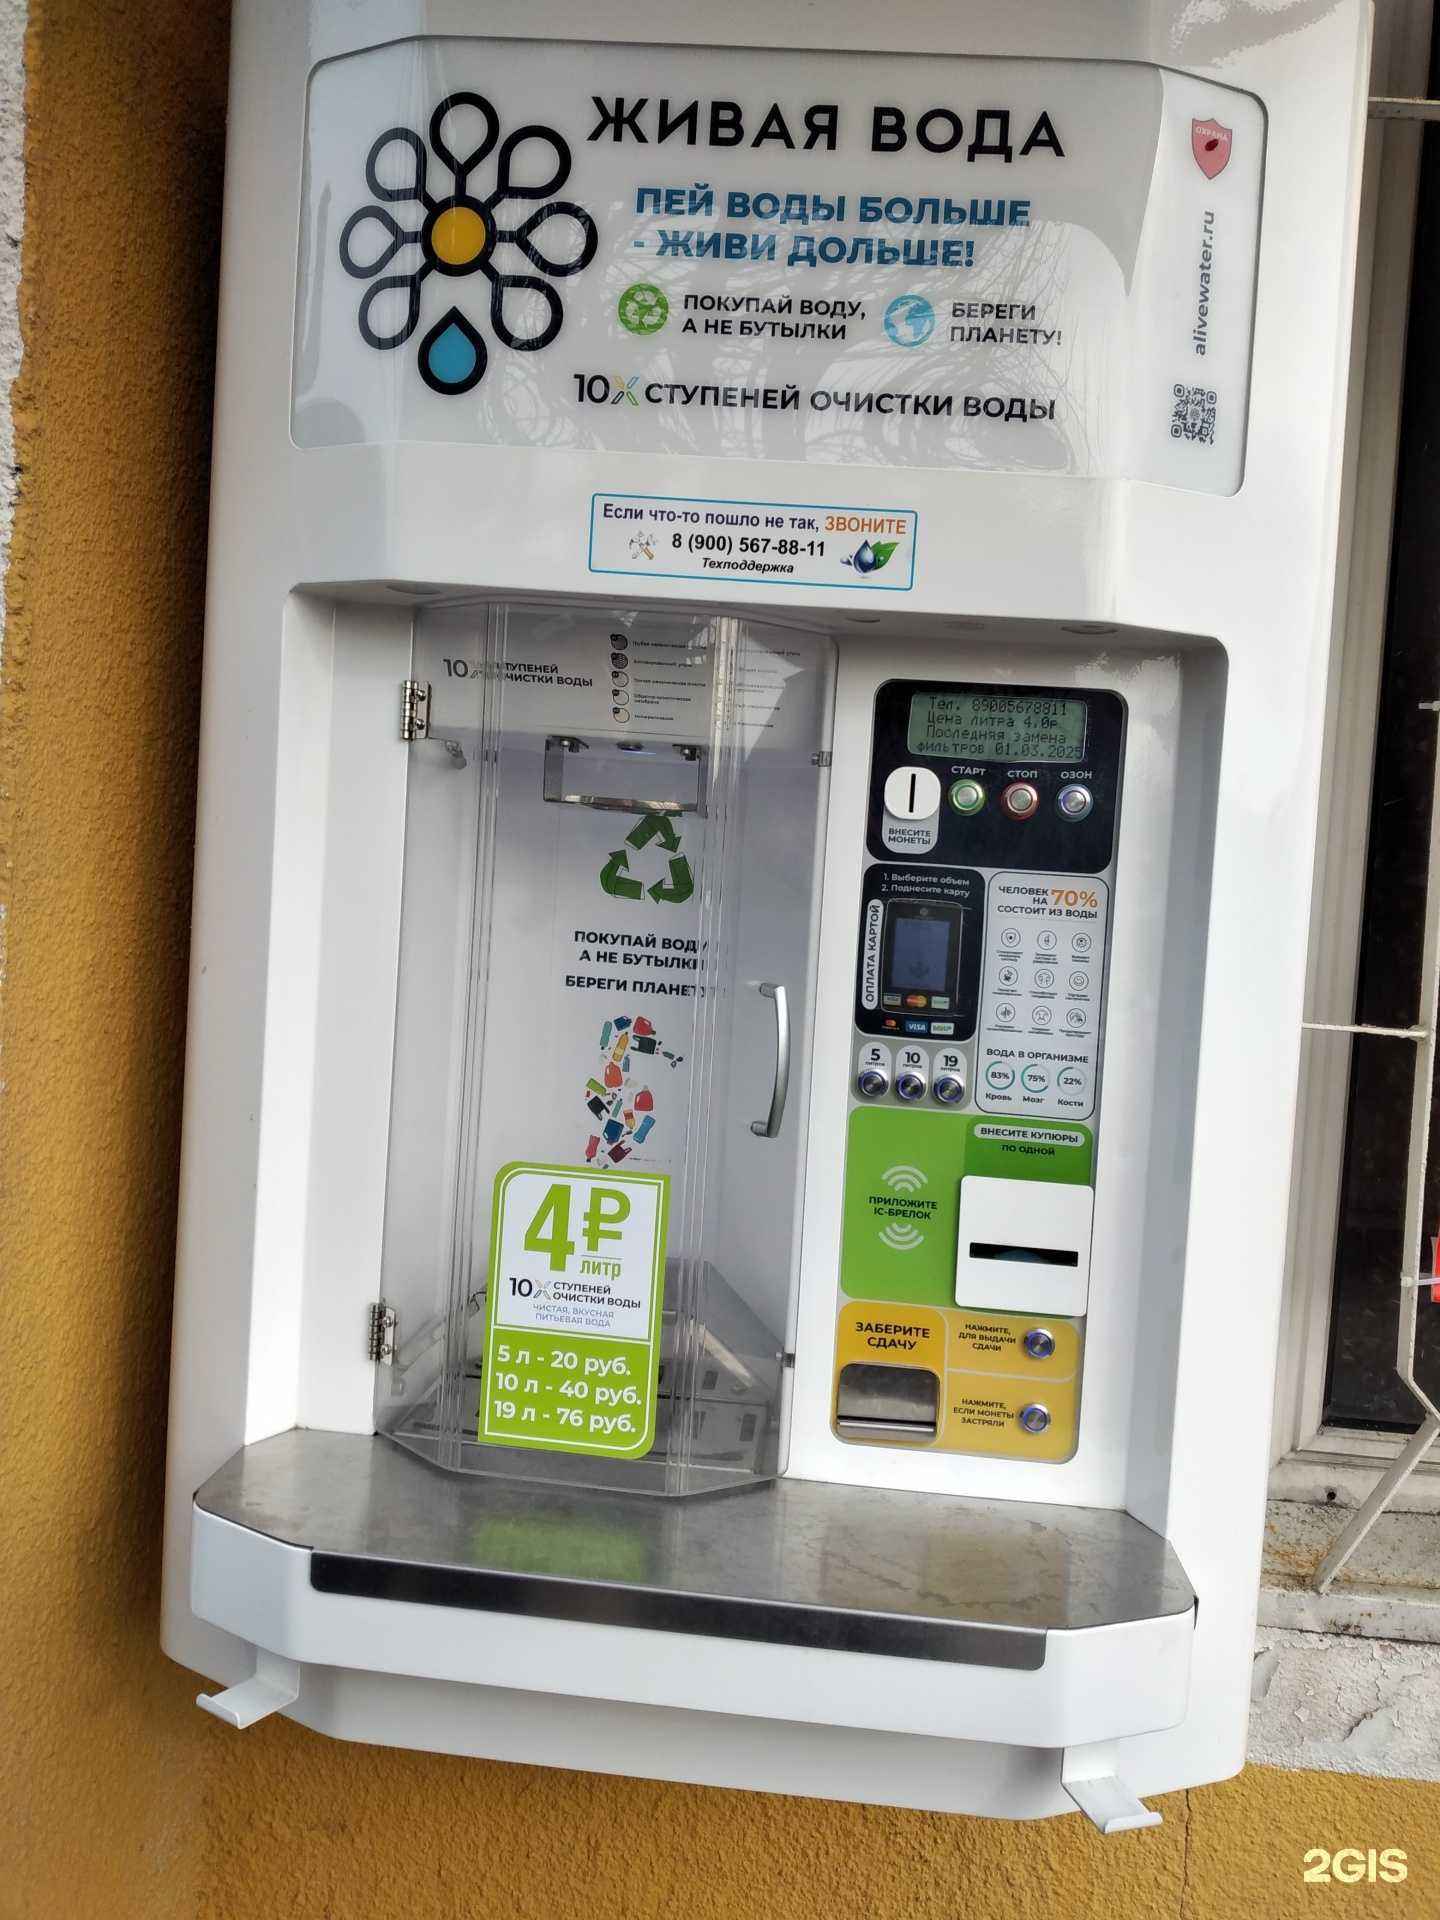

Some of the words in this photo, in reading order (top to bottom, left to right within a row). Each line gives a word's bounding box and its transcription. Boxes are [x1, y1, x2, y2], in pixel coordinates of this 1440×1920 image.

[586, 96, 838, 150] ЖИВАЯ
[871, 106, 1065, 163] ВОДА
[636, 182, 714, 217] ПЕЙ
[727, 191, 845, 225] ВОДЫ
[859, 196, 1031, 226] БОЛЬШЕ
[656, 230, 776, 261] ЖИВИ
[787, 235, 975, 268] ДОЛЬШЕ!
[1193, 210, 1215, 356] alivewater.ru
[683, 294, 792, 314] ПОКУПАЙ
[800, 300, 865, 320] ВОДУ,
[952, 302, 1035, 320] БЕРЕГИ
[682, 318, 697, 334] А
[704, 318, 732, 335] НЕ
[740, 320, 847, 340] БУТЫЛКИ
[950, 326, 1062, 346] ПЛАНЕТУ!
[645, 383, 800, 410] СТУПЕНЕЙ
[810, 390, 952, 416] ОЧИСТКИ
[963, 396, 1056, 422] ВОДЫ
[603, 503, 643, 520] Если
[649, 509, 700, 524] что-то
[705, 513, 759, 527] пошло
[765, 516, 784, 528] не
[789, 517, 819, 533] так,
[825, 516, 906, 534] ЗВОНИТЕ
[672, 533, 682, 548] 8
[688, 534, 733, 555] (900)
[739, 537, 825, 557] 567-88-11
[702, 557, 794, 574] Техподдержка
[557, 676, 593, 687] ВОДЫ
[929, 696, 960, 711] Тел.
[972, 700, 1067, 715] 89005678811
[928, 711, 962, 725] Цена
[970, 716, 1014, 728] литра
[926, 725, 1005, 740] Последняя
[1013, 732, 1066, 743] замена
[951, 765, 986, 776] СТАРТ
[1007, 770, 1038, 778] СТОП
[1060, 771, 1093, 779] ОЗОН
[888, 828, 931, 838] ВНЕСИТЕ
[888, 836, 931, 845] МОНЕТЫ
[884, 873, 889, 881] 1.
[892, 874, 938, 884] Выберите
[881, 884, 888, 892] 2.
[891, 885, 941, 894] Поднесите
[944, 888, 970, 898] карту
[998, 886, 1049, 896] ЧЕЛОВЕК
[1051, 889, 1098, 908] 70%
[1033, 897, 1048, 905] НА
[997, 905, 1045, 915] СОСТОИТ
[1049, 908, 1063, 916] ИЗ
[1066, 909, 1098, 919] ВОДЫ
[868, 904, 881, 951] КАРТОЙ
[574, 931, 656, 948] ПОКУПАЙ
[579, 950, 591, 961] А
[596, 951, 618, 963] НЕ
[565, 975, 627, 992] БЕРЕГИ
[865, 954, 876, 1002] ОПЛАТА
[870, 1048, 880, 1061] 5
[904, 1052, 920, 1064] 10
[943, 1055, 958, 1067] 19
[986, 1048, 1015, 1058] ВОДА
[1018, 1050, 1025, 1058] В
[1027, 1051, 1089, 1064] ОРГАНИЗМЕ
[1027, 1074, 1046, 1083] 75%
[1063, 1077, 1082, 1086] 22%
[985, 1092, 1012, 1102] Кровь
[1022, 1096, 1045, 1104] Мозг
[1057, 1098, 1084, 1107] Кости
[980, 1127, 1028, 1138] ВНЕСИТЕ
[1030, 1131, 1078, 1143] КУПЮРЫ
[1001, 1144, 1016, 1152] ПО
[1018, 1145, 1055, 1156] ОДНОЙ
[869, 1196, 937, 1209] ПРИЛОЖИТЕ
[873, 1207, 931, 1220] IC-БРЕЛОК
[580, 1260, 621, 1280] литр
[553, 1281, 611, 1294] СТУПЕНЕЙ
[552, 1292, 605, 1304] ОЧИСТКИ
[607, 1297, 641, 1309] ВОДЫ
[572, 1307, 614, 1318] ВКУСНАЯ
[535, 1313, 583, 1324] ПИТЬЕВАЯ
[585, 1318, 611, 1328] ВОДА
[855, 1322, 930, 1339] ЗАБЕРИТЕ
[965, 1323, 1011, 1335] НАЖМИТЕ,
[867, 1336, 917, 1350] СДАЧУ
[958, 1332, 977, 1341] ДЛЯ
[979, 1334, 1016, 1344] ВЫДАЧИ
[971, 1342, 1002, 1351] СДАЧИ
[497, 1344, 510, 1362] 5
[515, 1349, 530, 1365] л
[550, 1350, 578, 1369] 20
[584, 1356, 630, 1376] руб.
[495, 1372, 518, 1391] 10
[524, 1378, 538, 1393] л
[559, 1380, 588, 1399] 40
[595, 1386, 642, 1406] руб.
[961, 1398, 1007, 1409] НАЖМИТЕ,
[494, 1400, 516, 1419] 19
[521, 1406, 536, 1422] л
[556, 1408, 583, 1427] 76
[589, 1414, 636, 1434] руб.
[953, 1407, 975, 1415] ЕСЛИ
[977, 1409, 1014, 1419] МОНЕТЫ
[960, 1417, 1005, 1427] ЗАСТРЯЛИ
